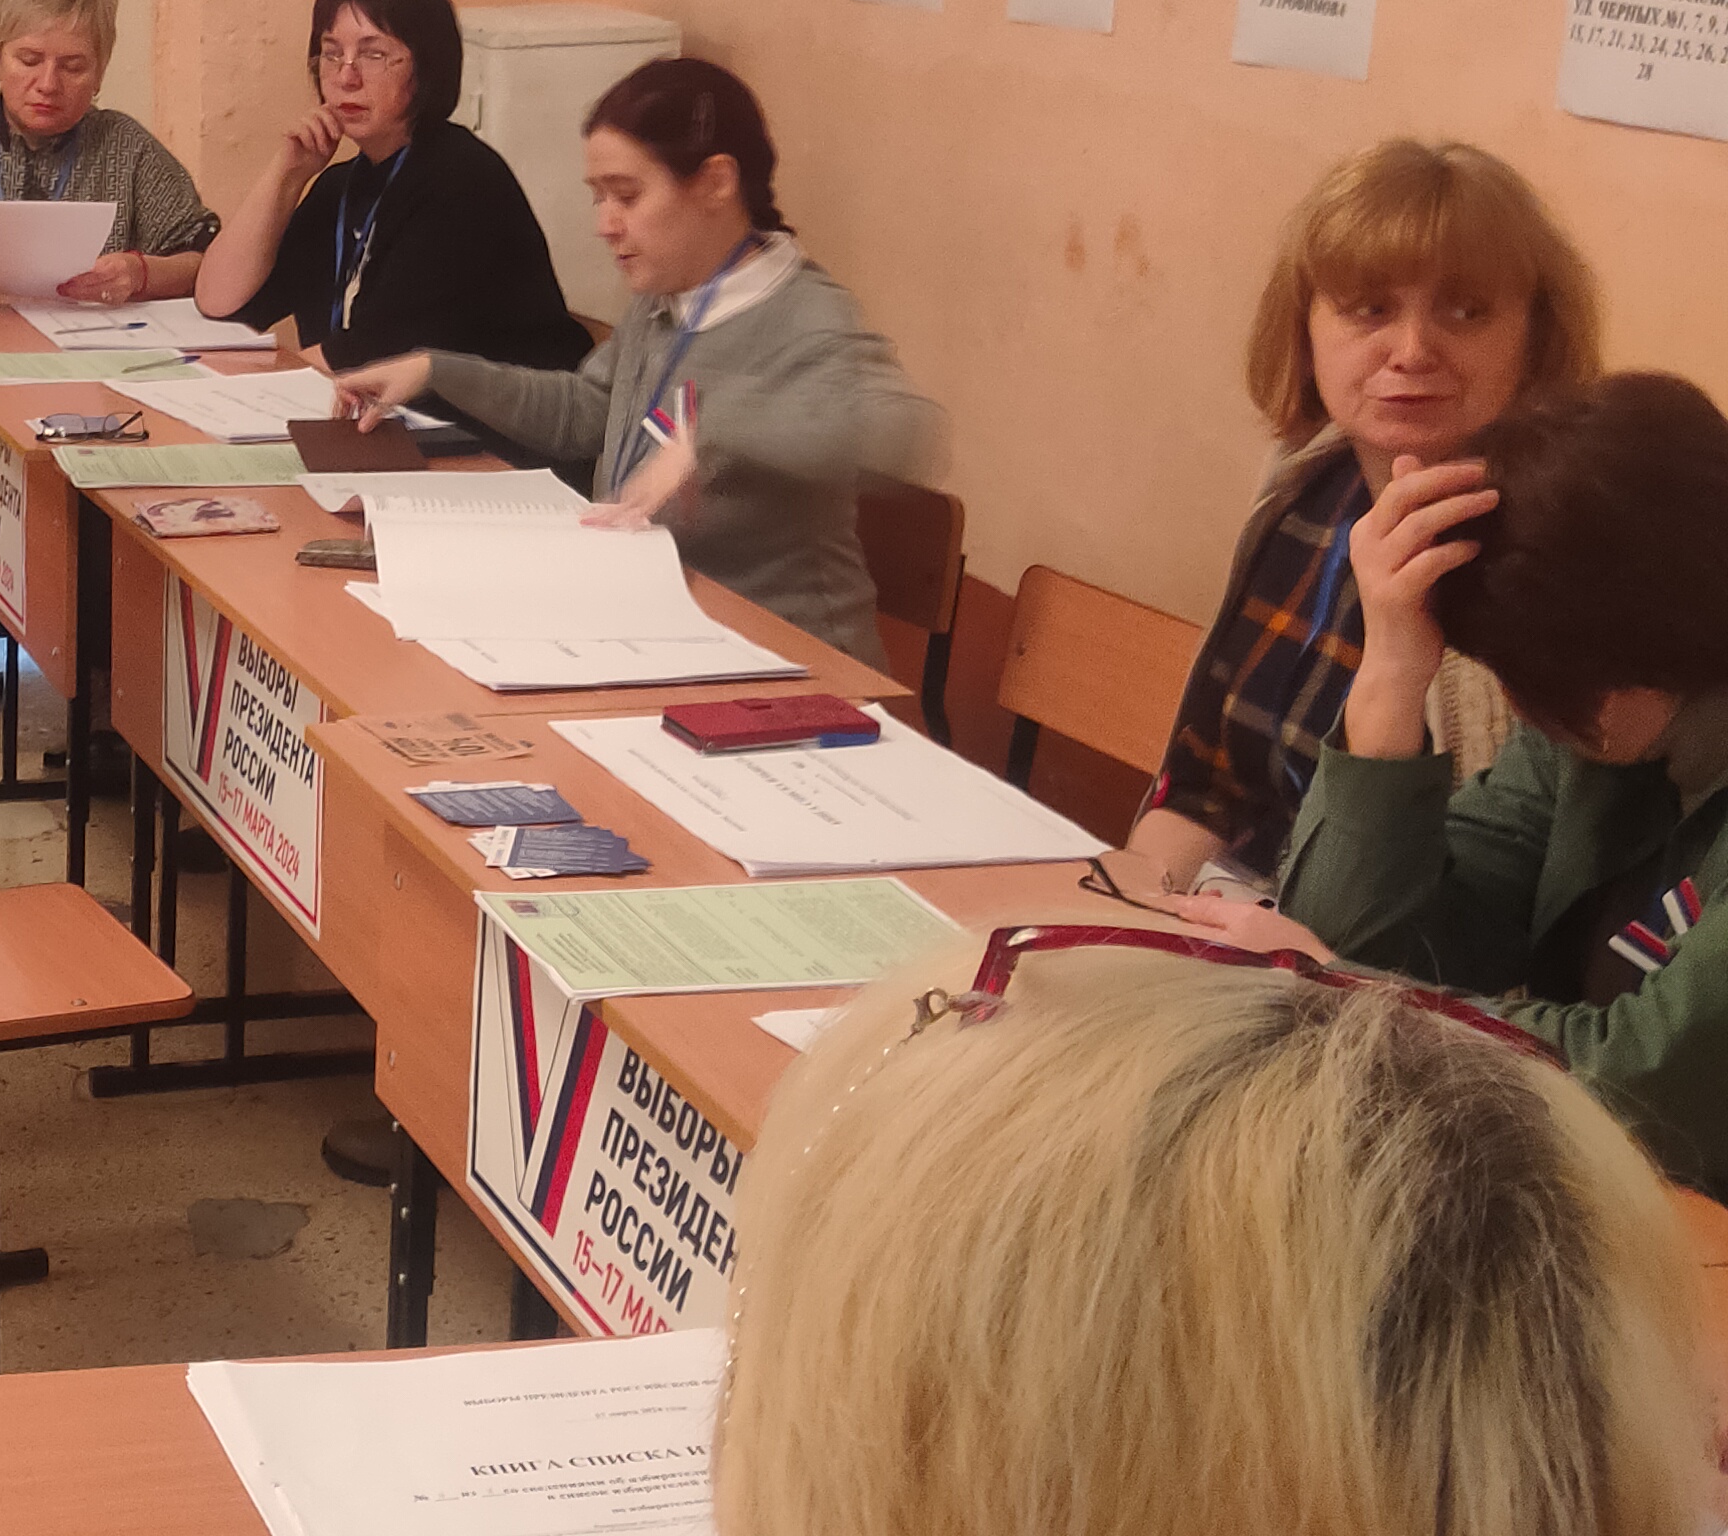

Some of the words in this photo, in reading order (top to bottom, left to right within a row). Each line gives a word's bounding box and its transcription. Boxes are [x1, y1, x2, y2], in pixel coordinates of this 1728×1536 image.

[1598, 0, 1662, 25] ЧЕРНЫХ
[237, 632, 299, 713] ВЫБОРЫ
[223, 726, 277, 806] РОССИИ
[230, 680, 316, 790] ПРЕЗИДЕНТА
[243, 797, 275, 856] МАРТА
[275, 831, 300, 882] 2024
[617, 1047, 743, 1196] ВЫБОРЫ
[584, 1171, 693, 1314] РОССИИ
[470, 1457, 564, 1476] КНИГА
[568, 1448, 681, 1468] СПИСКА
[685, 1443, 712, 1457] И
